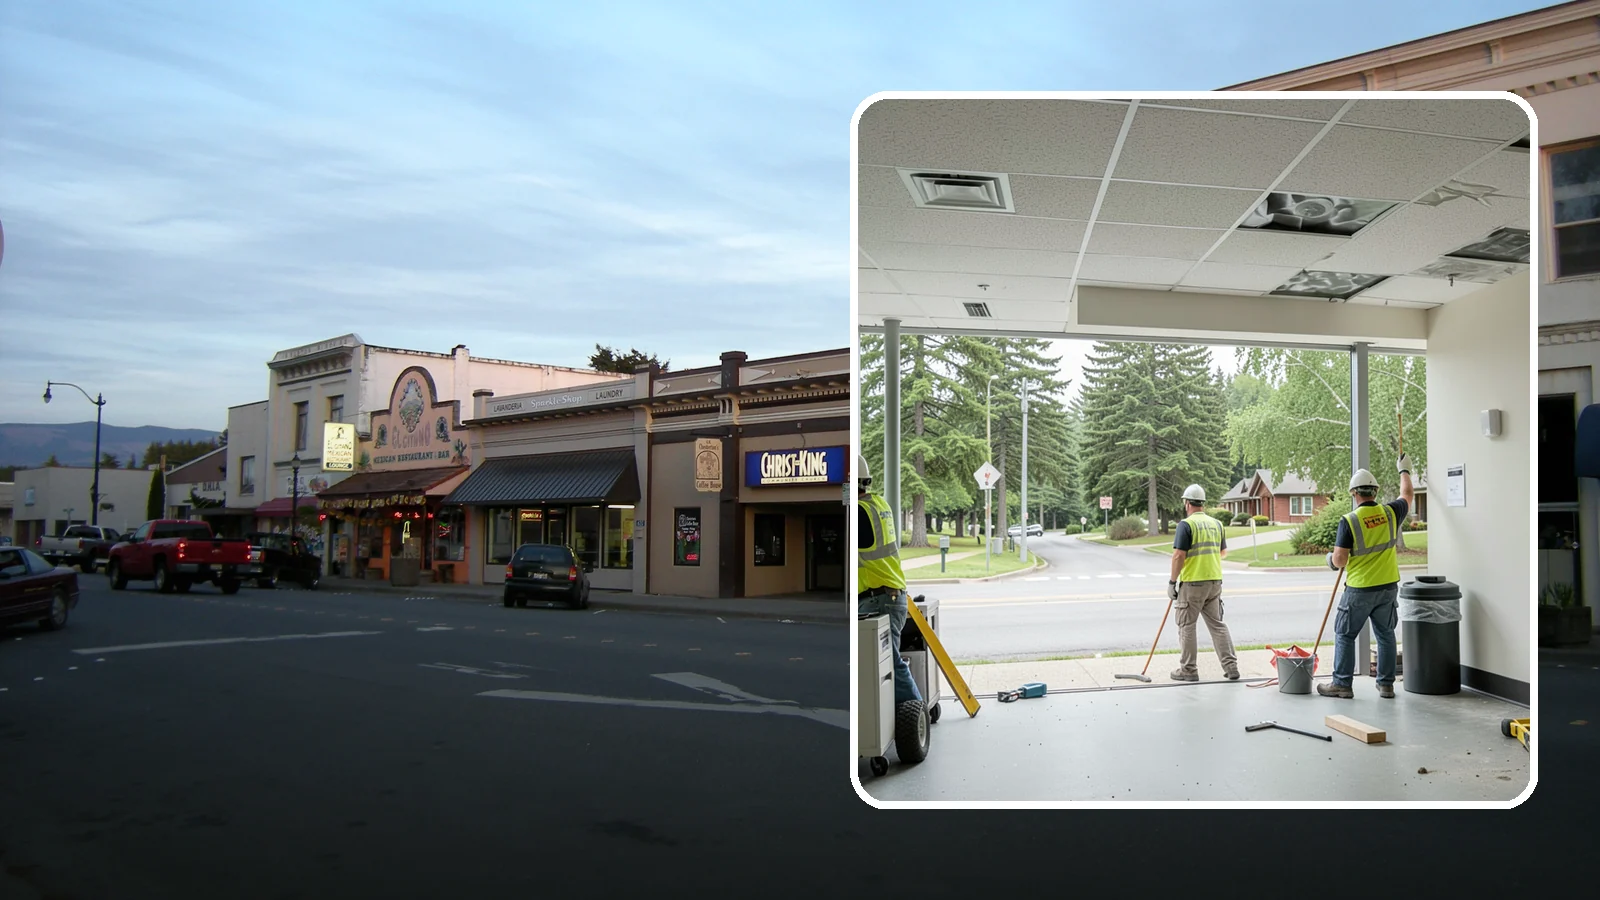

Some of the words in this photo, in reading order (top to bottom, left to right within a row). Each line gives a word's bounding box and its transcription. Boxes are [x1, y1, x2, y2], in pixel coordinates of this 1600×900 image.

[595, 389, 623, 399] LAUNDRY
[493, 402, 523, 412] LAVANDERIA
[530, 397, 561, 409] Sparkle
[562, 395, 583, 404] Shop
[374, 454, 396, 464] MEXICAN
[398, 451, 433, 462] RESTAURANT
[438, 450, 450, 459] BAR
[761, 452, 798, 478] CHRIST
[799, 450, 827, 476] KING
